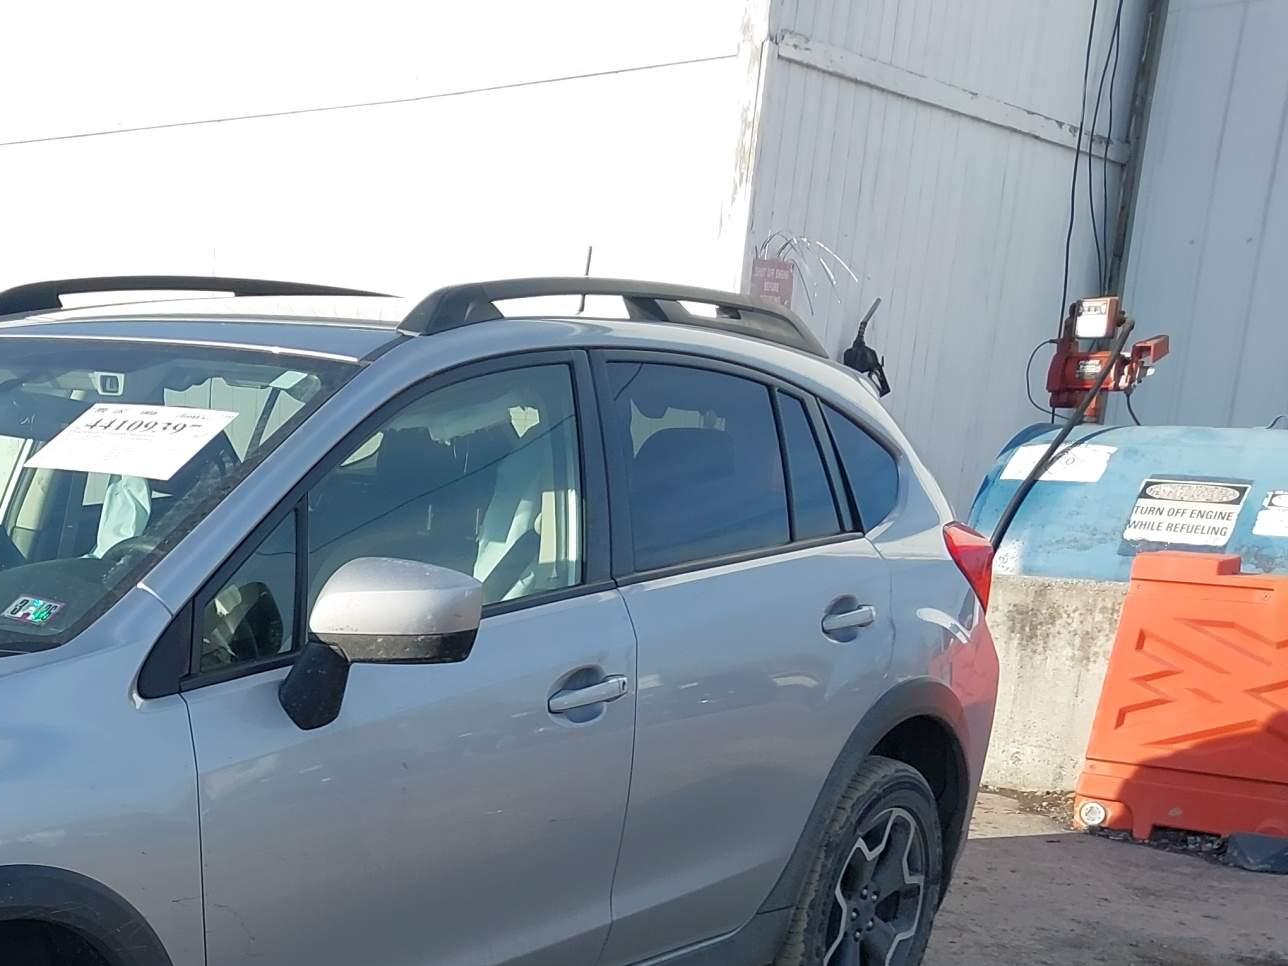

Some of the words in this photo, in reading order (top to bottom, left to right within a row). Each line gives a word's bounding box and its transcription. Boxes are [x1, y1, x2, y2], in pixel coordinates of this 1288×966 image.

[1132, 505, 1165, 517] TURN
[1167, 507, 1188, 518] OFF
[1189, 509, 1235, 521] ENGINE
[1128, 520, 1164, 532] WHILE
[1165, 522, 1229, 537] REFUELING
